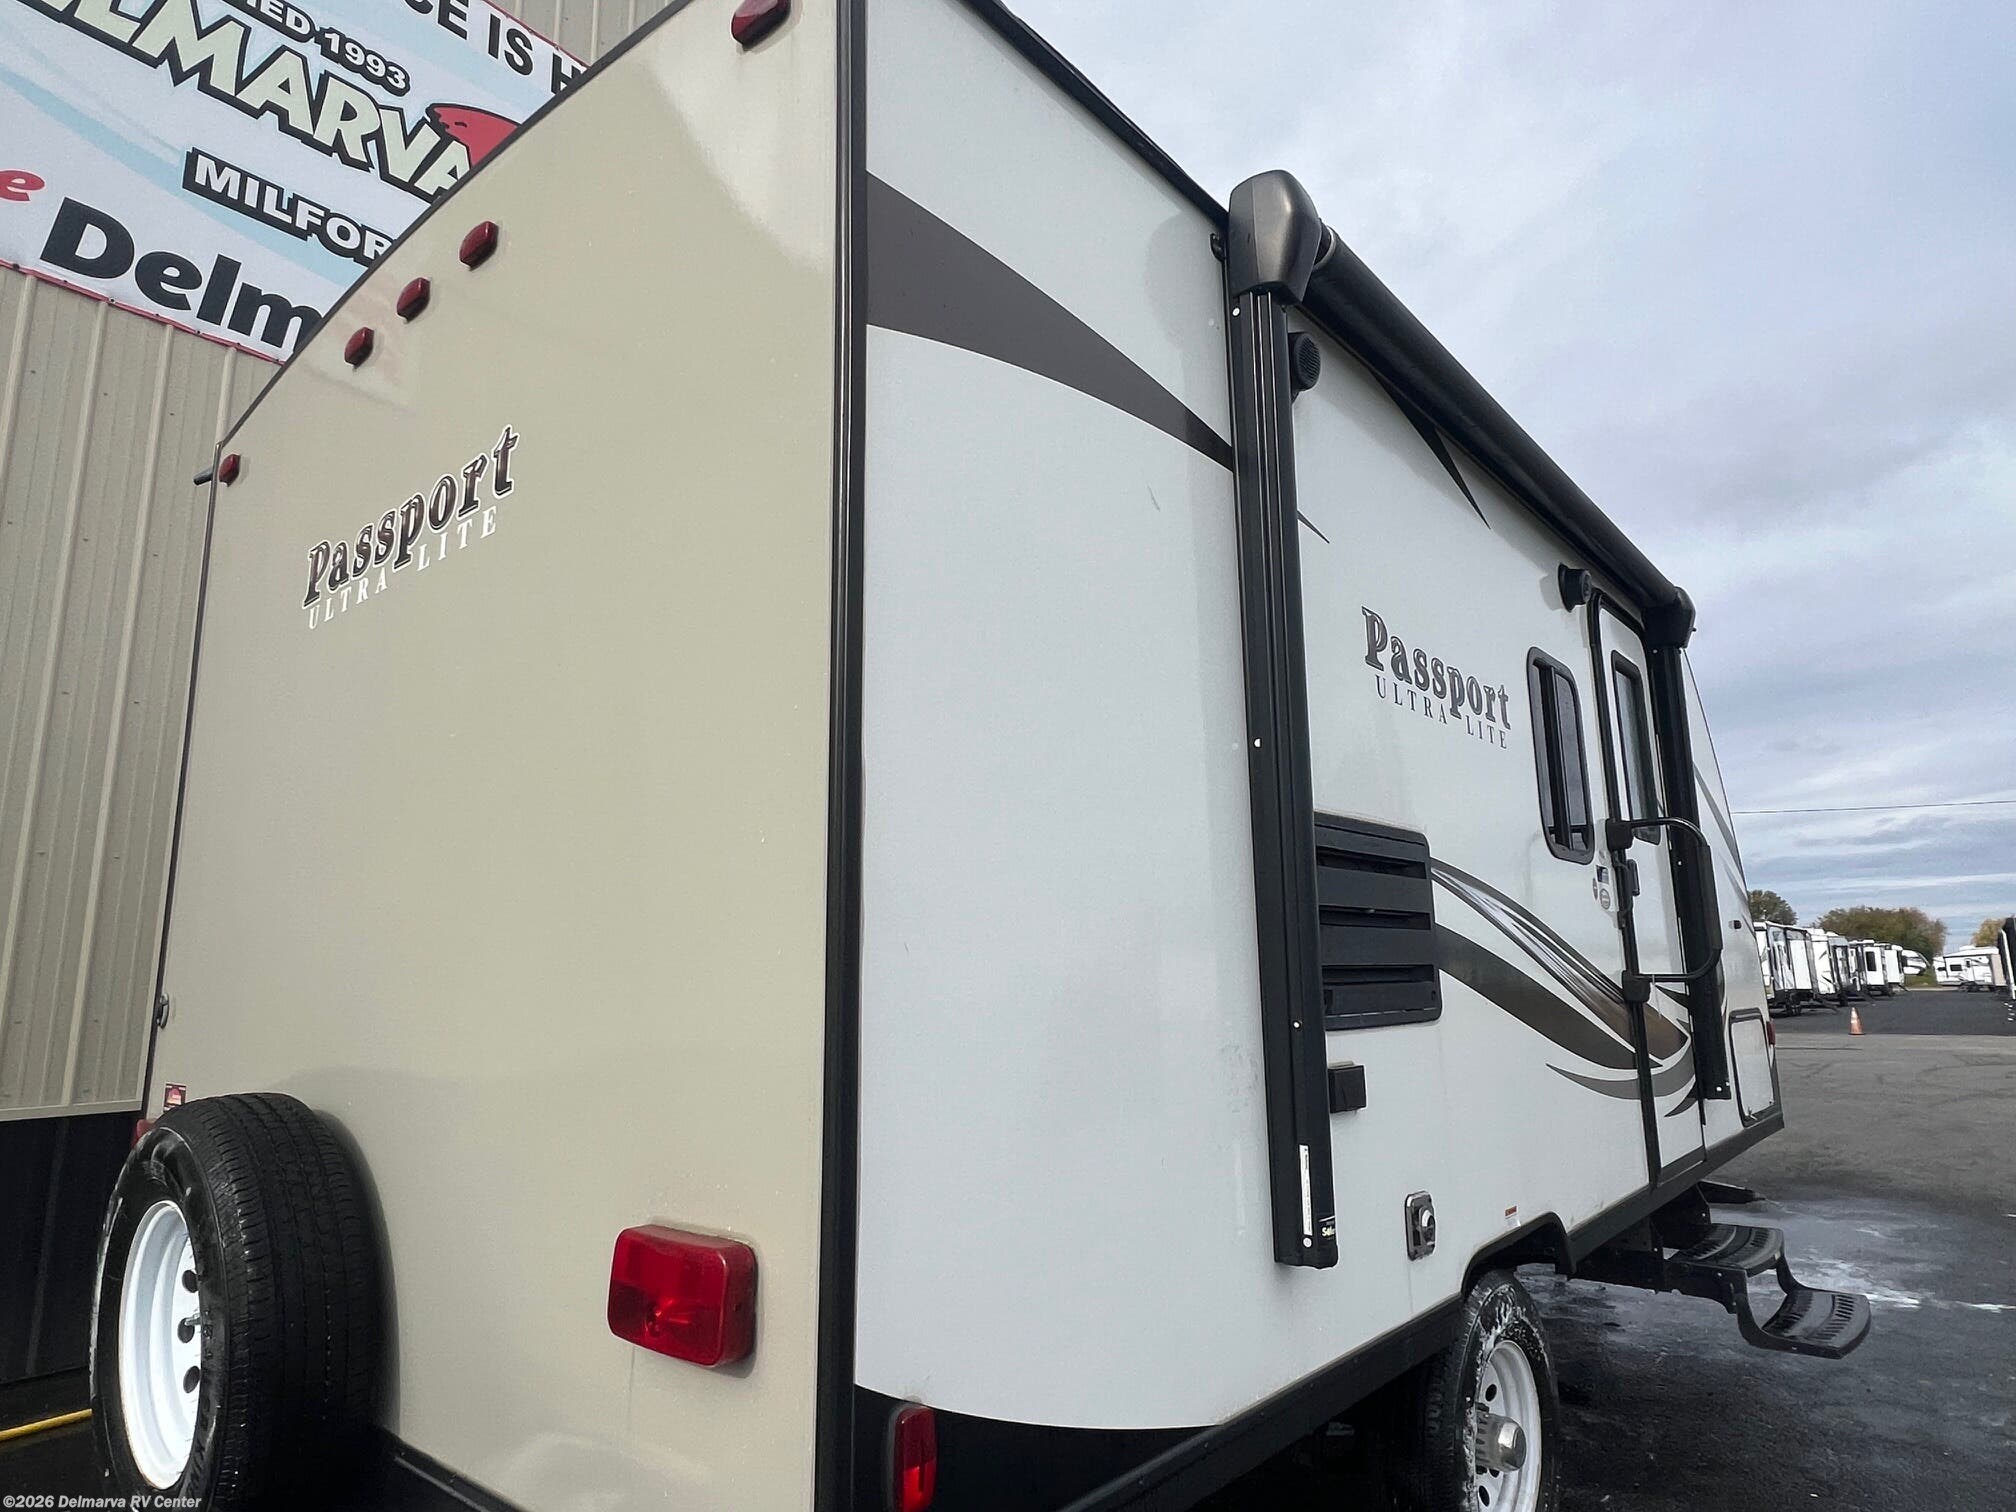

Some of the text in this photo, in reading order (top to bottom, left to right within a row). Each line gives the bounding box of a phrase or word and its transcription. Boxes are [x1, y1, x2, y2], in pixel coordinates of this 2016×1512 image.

[324, 32, 407, 90] 1993
[487, 13, 534, 76] IS
[302, 424, 519, 610] Passport
[308, 505, 498, 629] ULTRA LITE
[1361, 605, 1512, 731] Passport
[1375, 673, 1508, 750] ULTRA LITE
